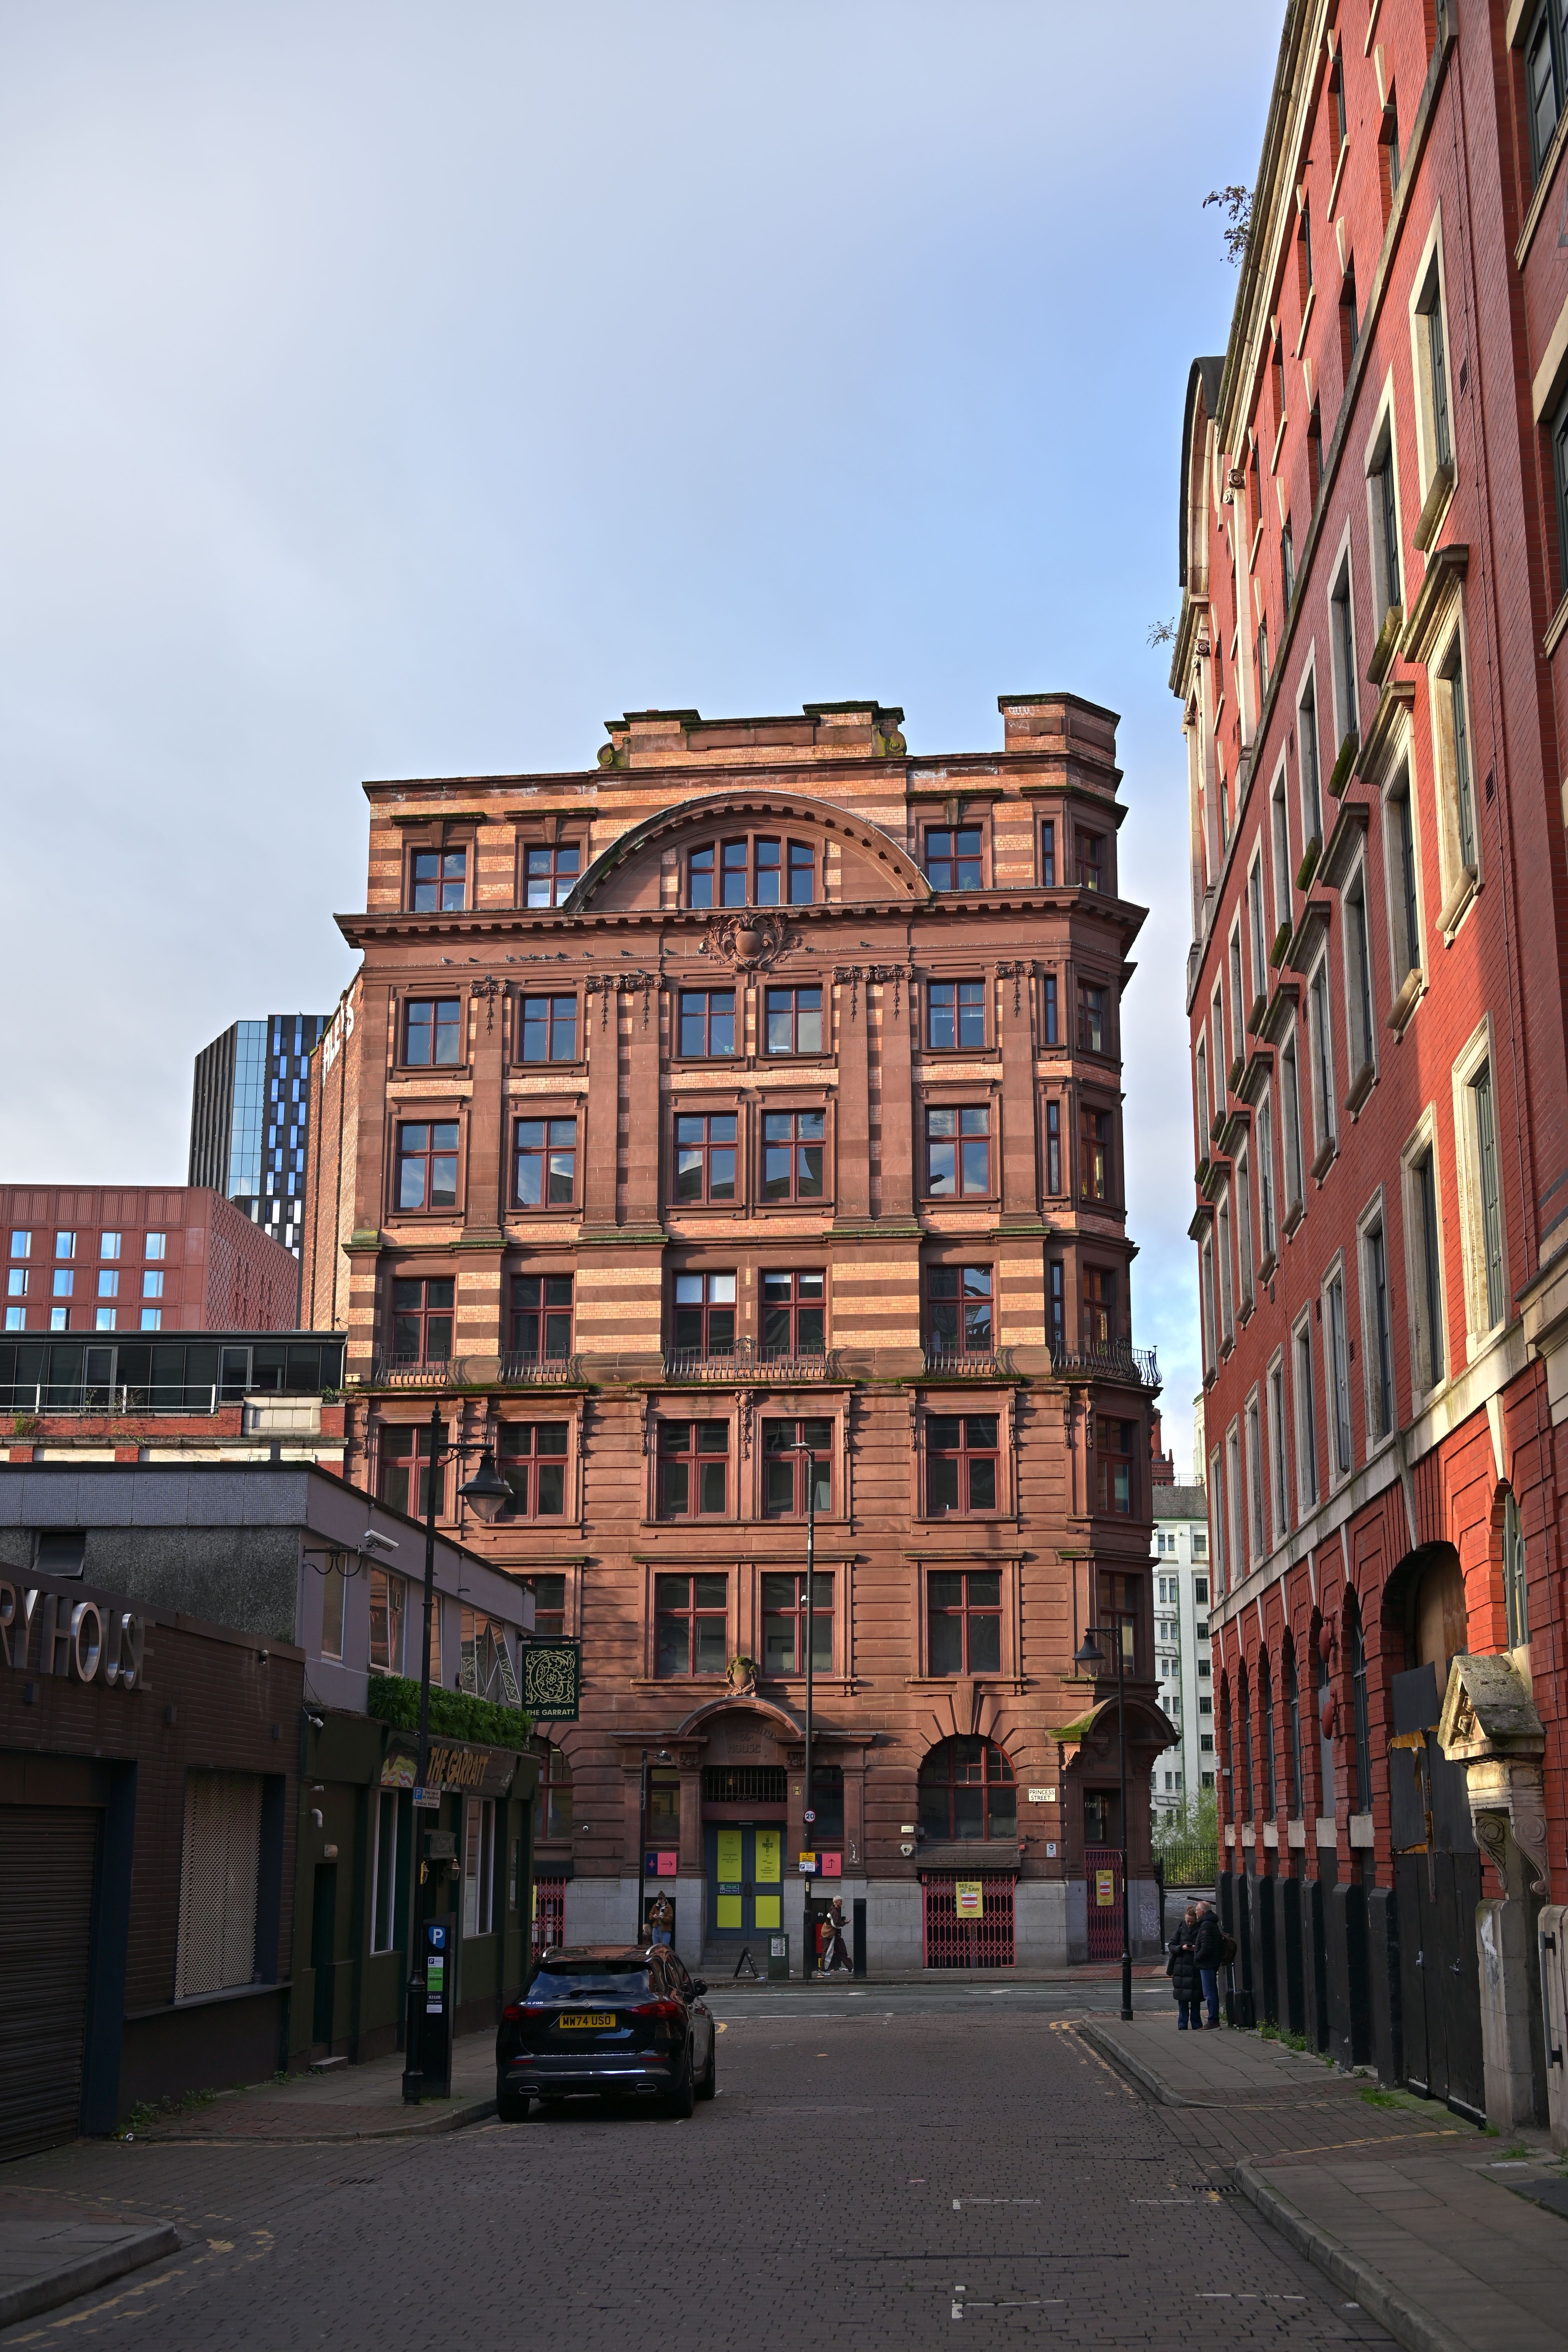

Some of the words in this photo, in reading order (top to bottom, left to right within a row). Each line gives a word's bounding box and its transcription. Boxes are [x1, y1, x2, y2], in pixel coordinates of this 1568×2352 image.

[728, 1744, 761, 1753] HOUSE
[427, 1747, 449, 1781] THE
[447, 1750, 488, 1786] GARRATT
[433, 1929, 443, 1944] P
[563, 2016, 588, 2026] MW74
[592, 2016, 611, 2025] USO
